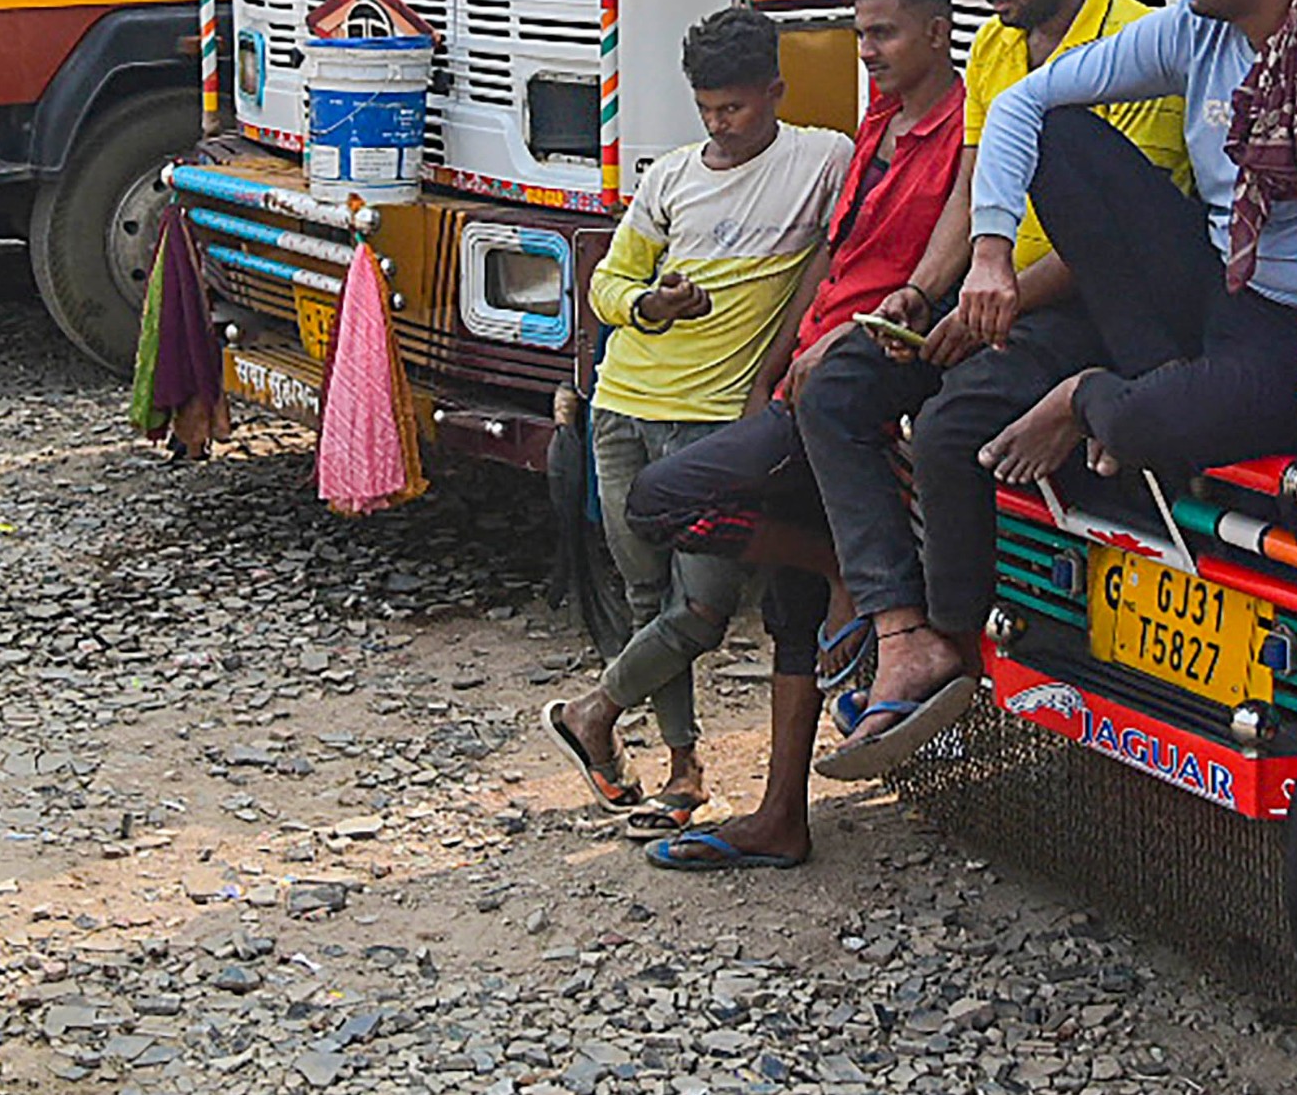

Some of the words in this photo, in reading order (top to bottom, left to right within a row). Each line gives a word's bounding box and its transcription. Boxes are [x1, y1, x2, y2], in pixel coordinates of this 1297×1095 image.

[1157, 570, 1225, 633] GJ31
[1140, 615, 1221, 685] T5827
[1077, 707, 1235, 803] JAGUAR
